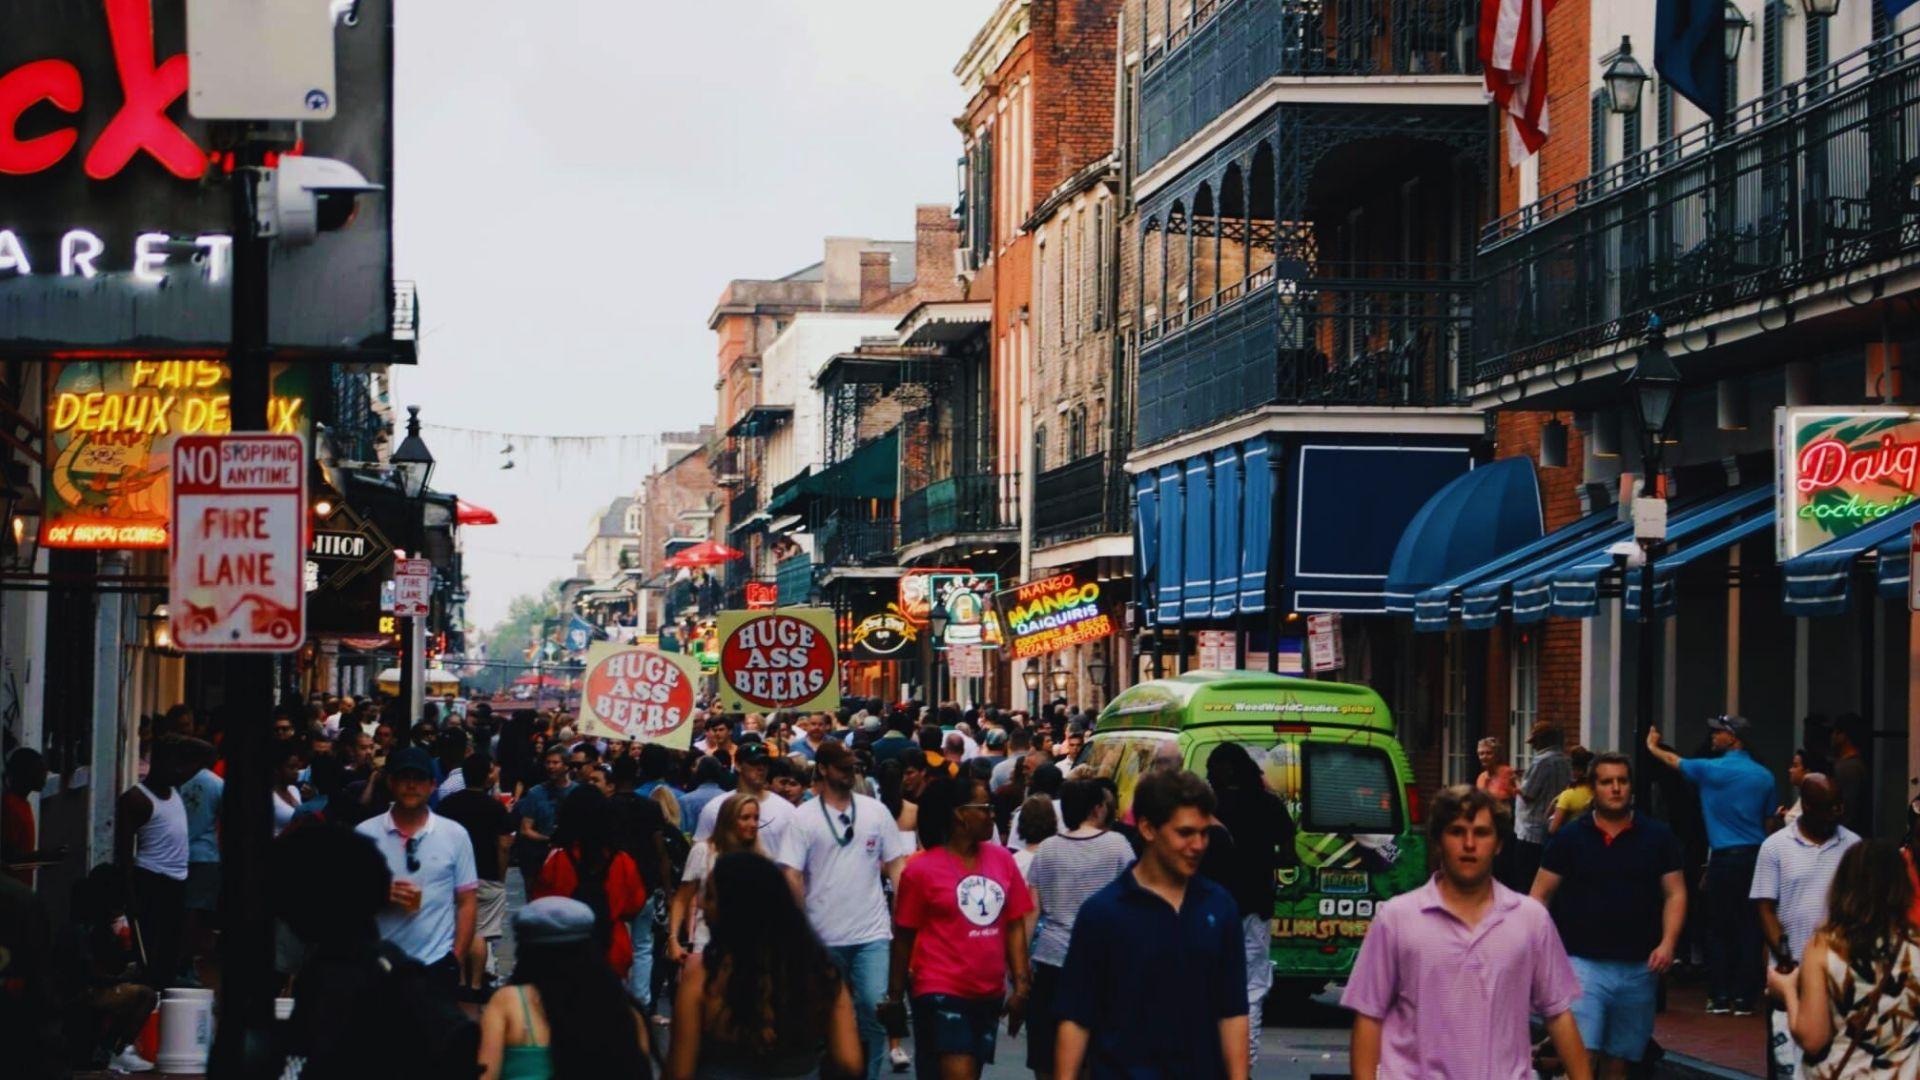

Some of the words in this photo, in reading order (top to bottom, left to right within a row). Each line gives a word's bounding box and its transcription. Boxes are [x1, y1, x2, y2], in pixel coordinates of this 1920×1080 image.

[132, 360, 223, 389] FAIS
[54, 392, 176, 435] DEAUX
[181, 395, 303, 435] DEX
[176, 446, 218, 485] NO
[222, 443, 298, 463] STOPPING
[1797, 438, 1920, 492] Daiq
[226, 467, 293, 484] ANYTIME
[202, 506, 271, 540] FIRE
[197, 553, 275, 587] LANE
[1019, 574, 1074, 600] MANGO
[1008, 582, 1100, 629] MANGO
[1016, 604, 1099, 635] DAIQUIRIS
[739, 618, 815, 649] HUGE
[606, 652, 679, 688] HUGE
[745, 647, 809, 669] ASS
[610, 677, 671, 704] ASS
[734, 668, 824, 701] BEERS
[595, 694, 681, 736] BEERS
[977, 898, 989, 917] 1
